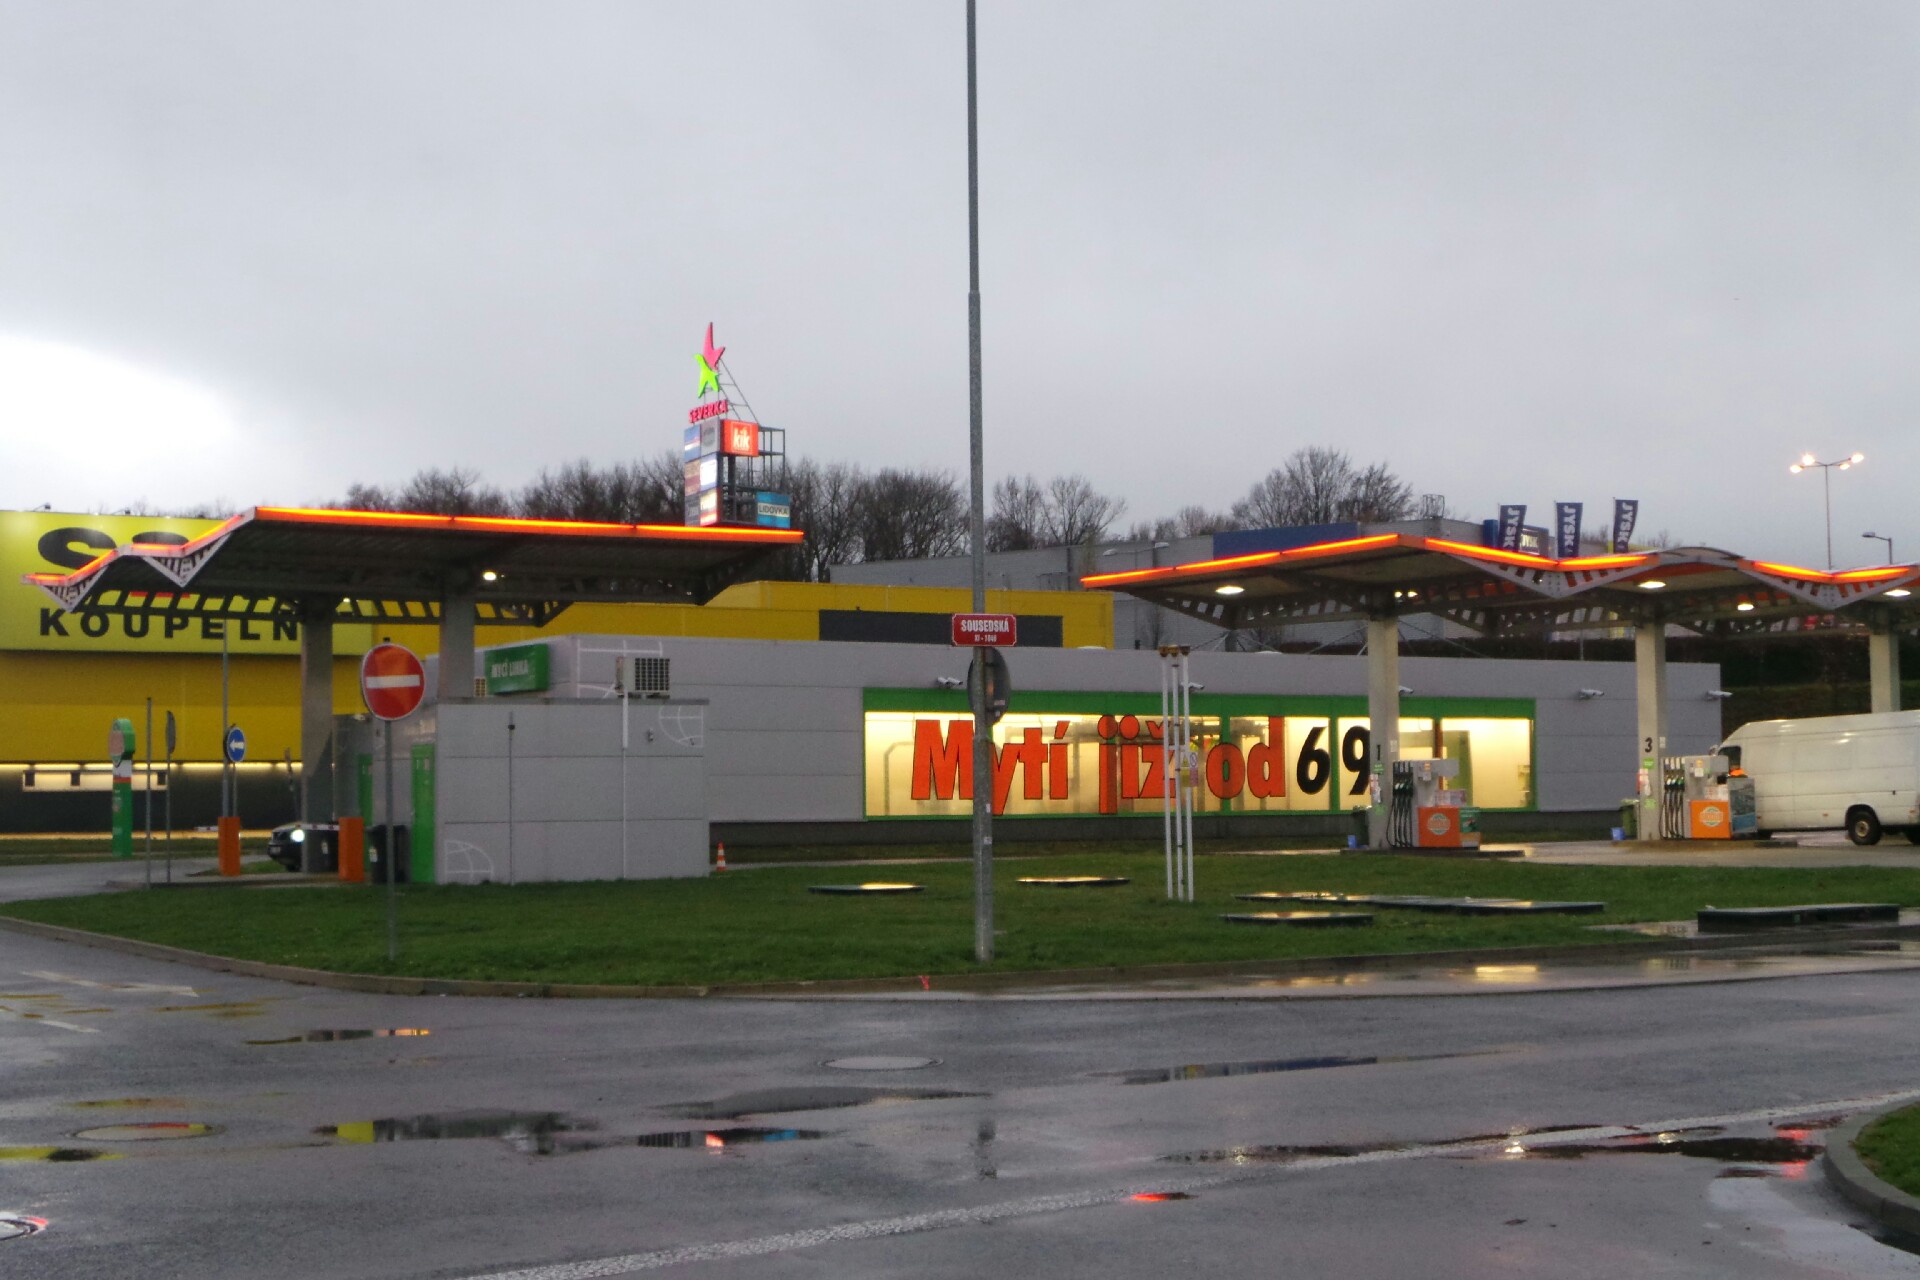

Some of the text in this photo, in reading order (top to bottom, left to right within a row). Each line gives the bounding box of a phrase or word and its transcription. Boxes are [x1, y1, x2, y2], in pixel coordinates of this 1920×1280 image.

[688, 399, 728, 424] SEVERKA
[732, 426, 750, 451] kik
[759, 503, 788, 516] LIDOVKA
[1503, 507, 1520, 548] JYSK
[1563, 505, 1576, 547] JYSK
[1617, 502, 1633, 543] JYSK
[961, 618, 1009, 632] SOUSEDSKÁ
[1644, 737, 1653, 753] 3
[911, 714, 1370, 816] Mytí již od 69
